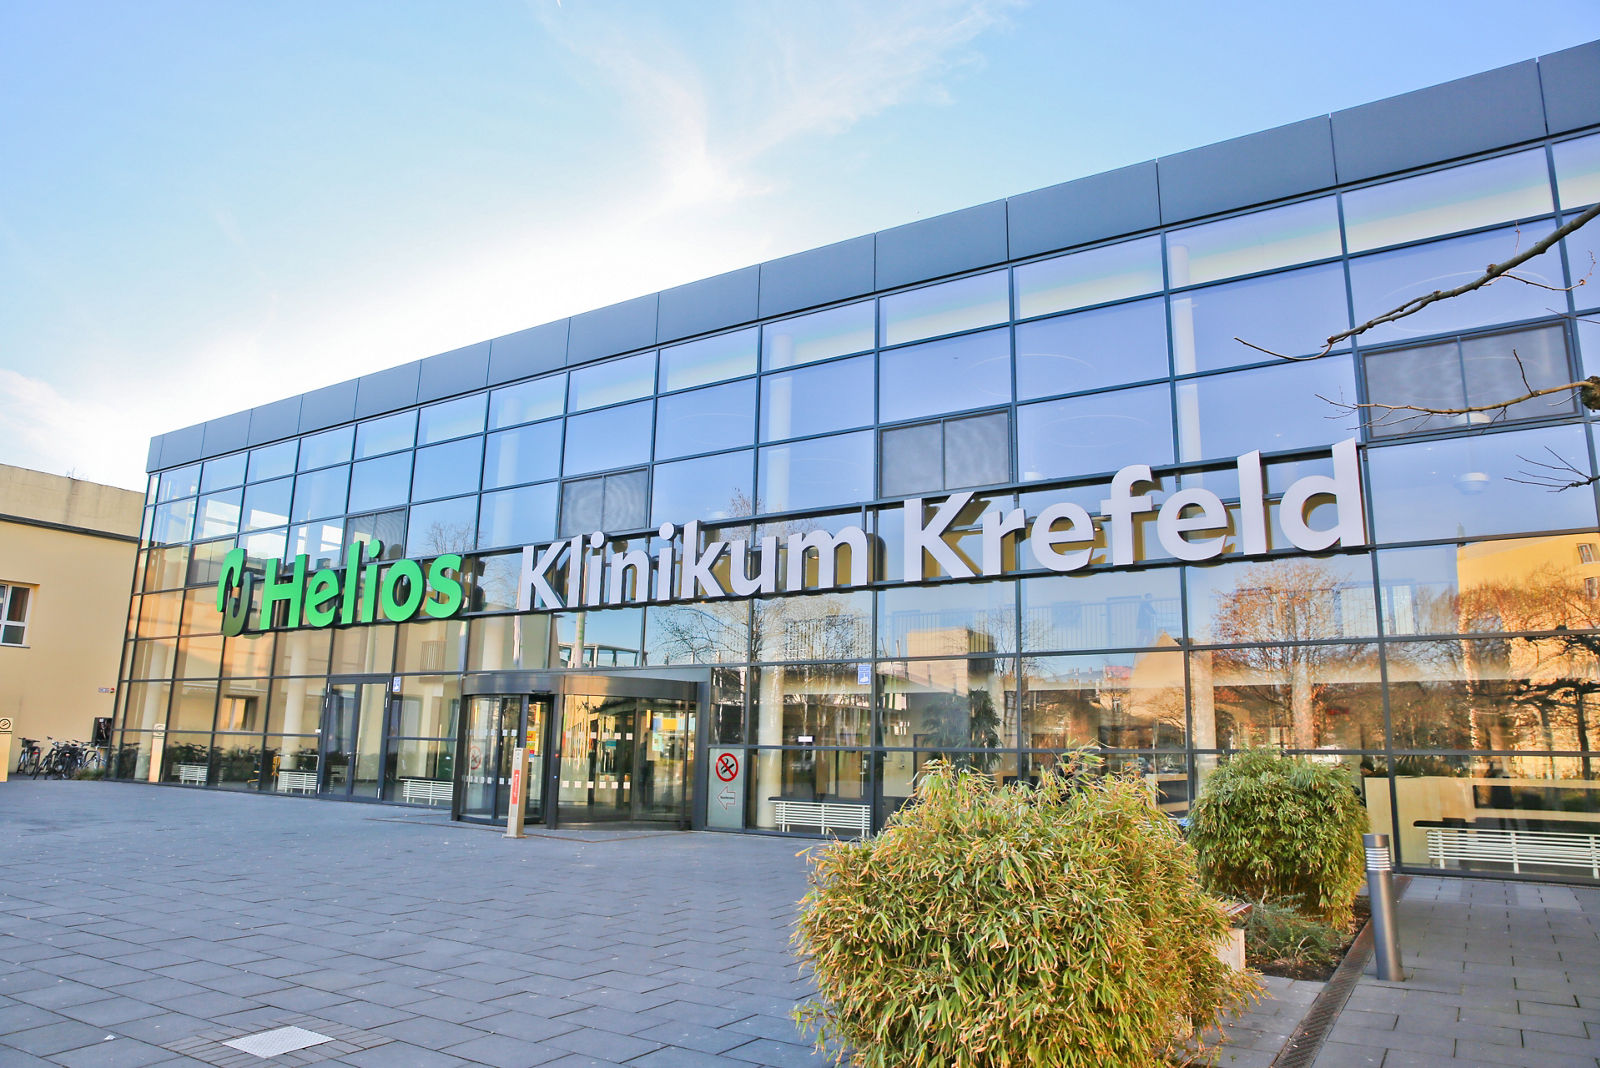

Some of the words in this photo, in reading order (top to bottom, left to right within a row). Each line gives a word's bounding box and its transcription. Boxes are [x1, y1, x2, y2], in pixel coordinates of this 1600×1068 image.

[259, 539, 464, 630] Helios
[520, 520, 871, 611] Klinikum
[904, 439, 1366, 582] Krefeld
